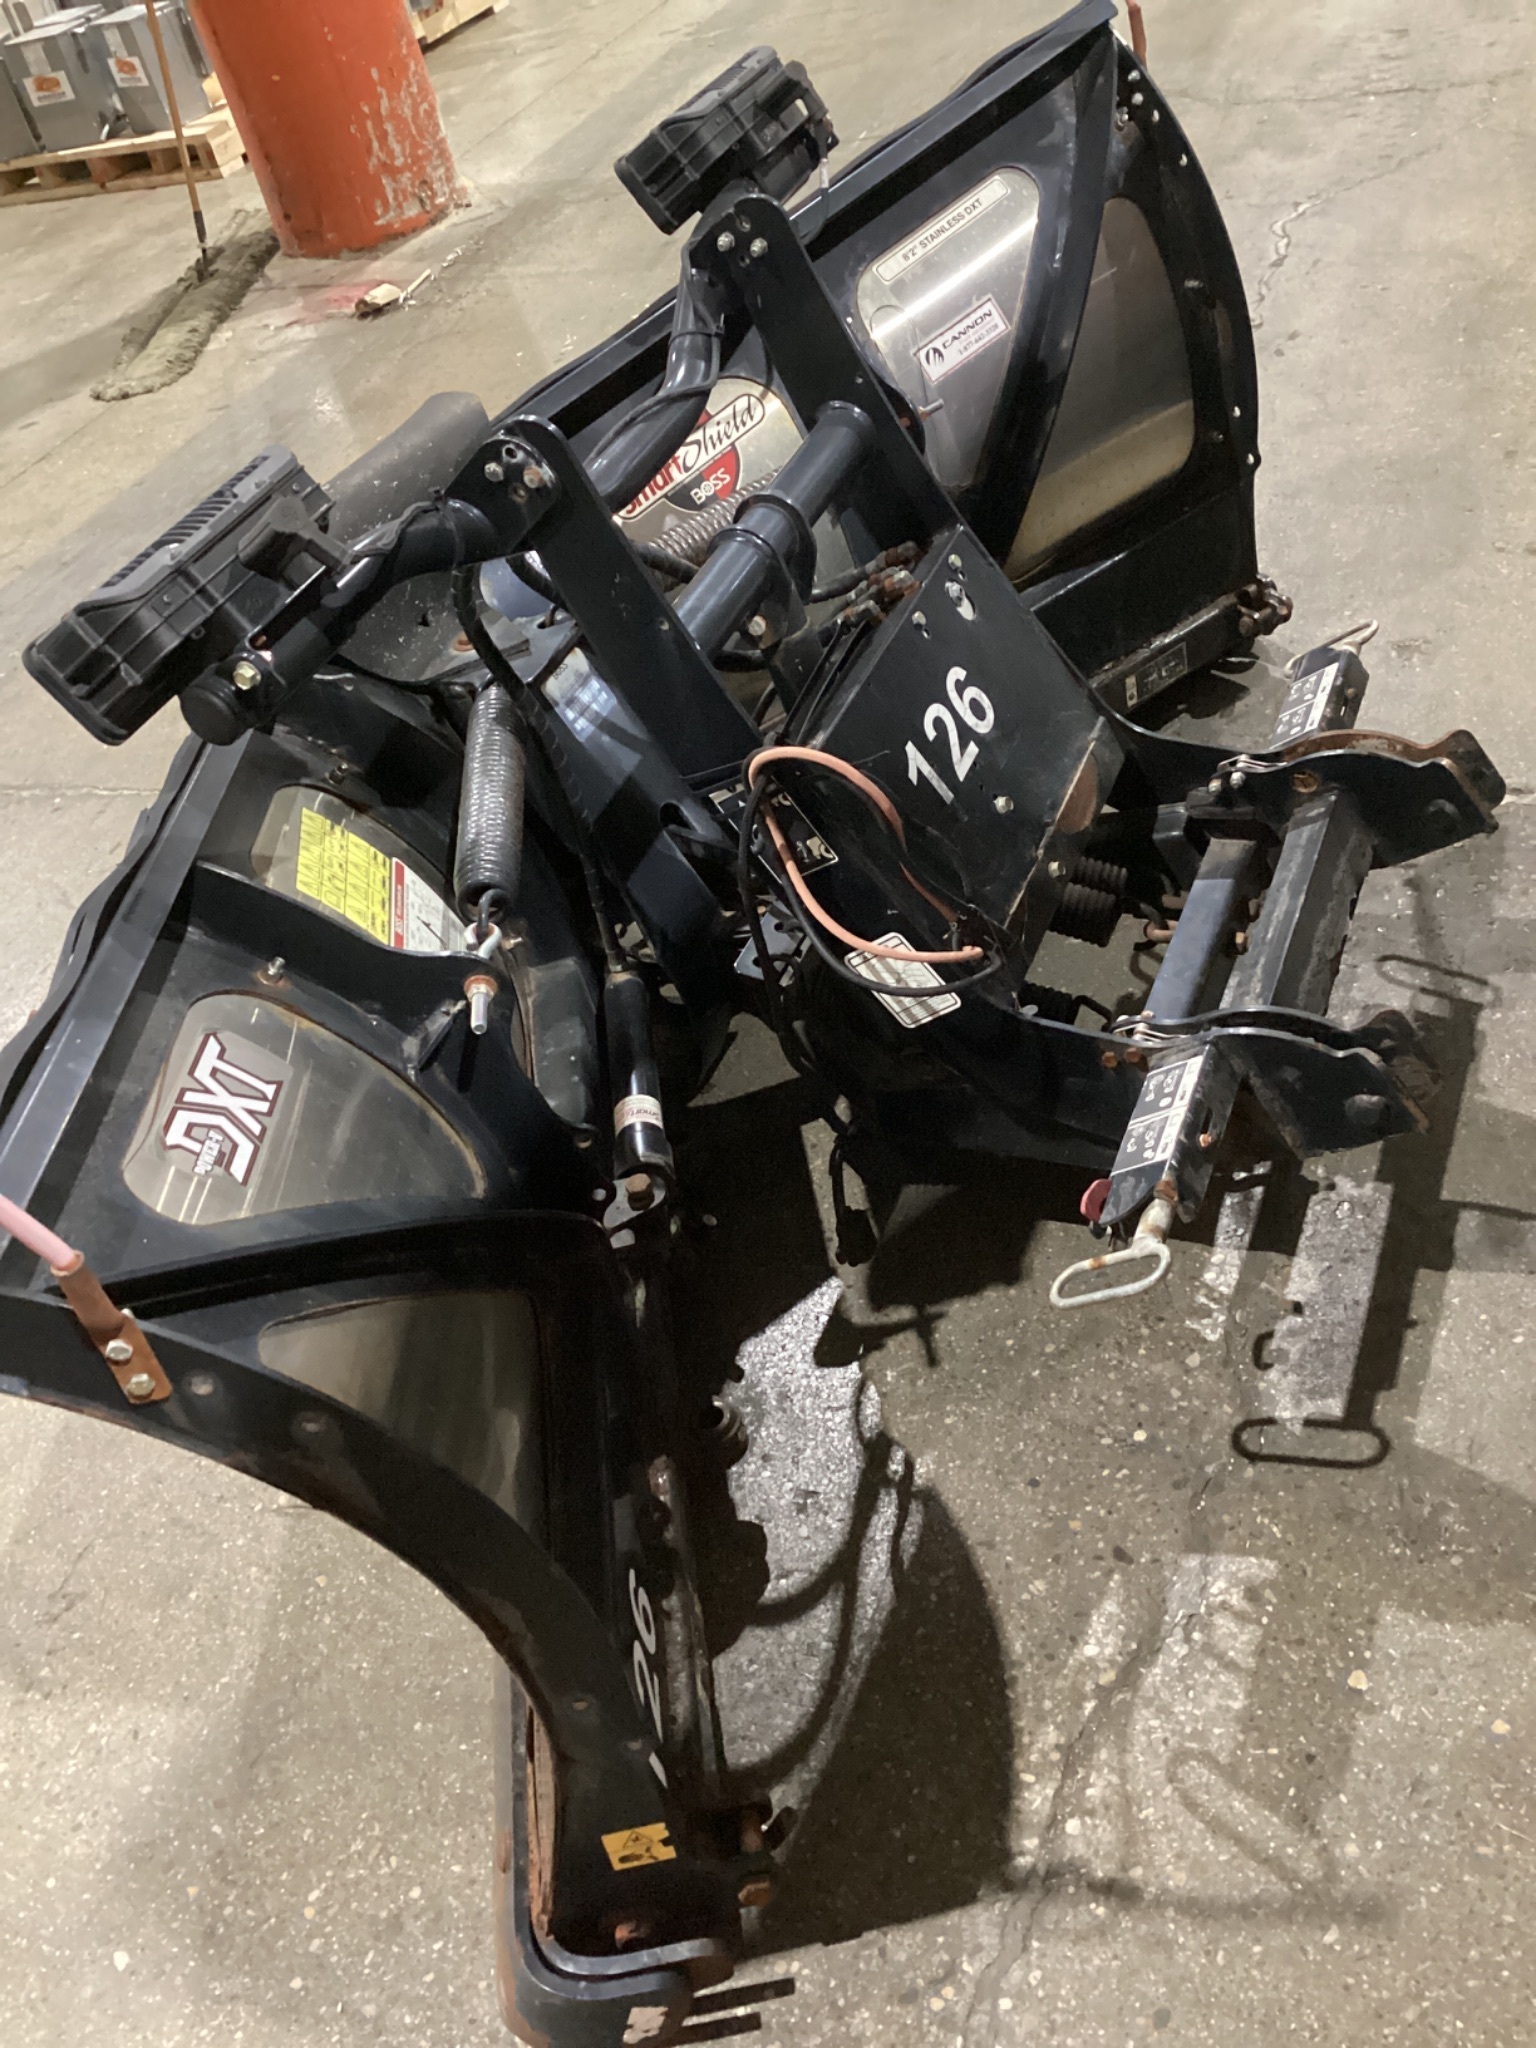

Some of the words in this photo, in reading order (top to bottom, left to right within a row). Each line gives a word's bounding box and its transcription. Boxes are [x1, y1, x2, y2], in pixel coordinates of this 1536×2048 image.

[918, 211, 966, 250] STAINLESS
[964, 197, 984, 216] DXT
[942, 308, 994, 350] CANNON
[689, 467, 731, 505] BOSS
[904, 665, 995, 805] 126
[162, 1031, 284, 1188] DXT
